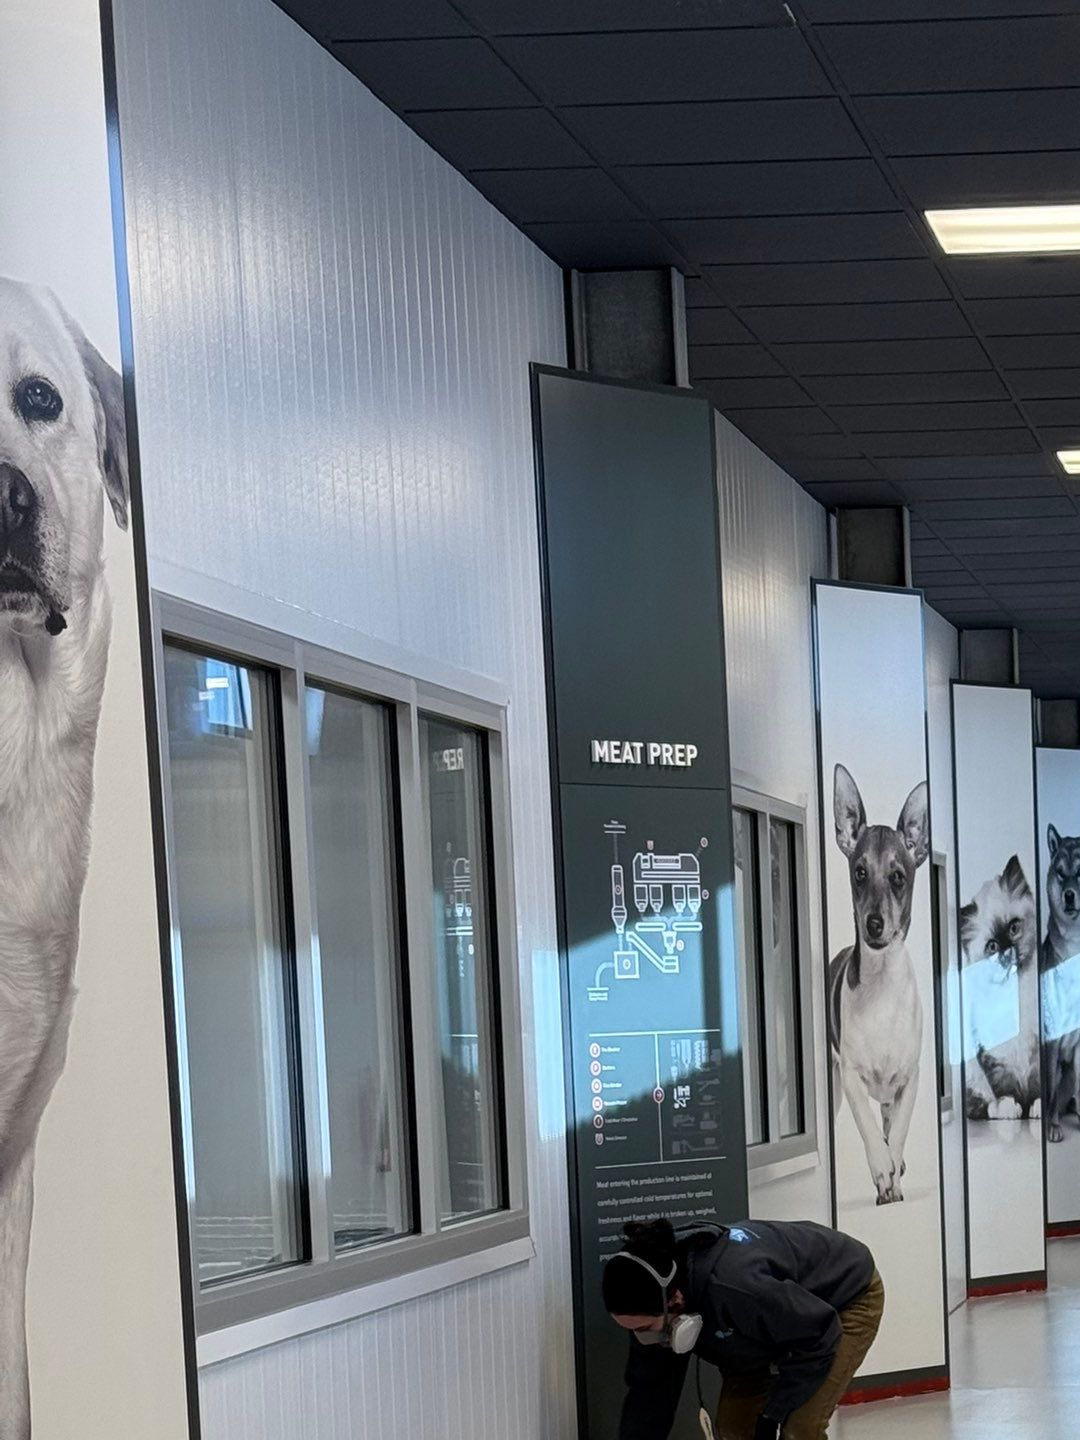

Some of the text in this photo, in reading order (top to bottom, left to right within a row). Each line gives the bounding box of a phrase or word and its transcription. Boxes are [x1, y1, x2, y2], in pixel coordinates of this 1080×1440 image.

[591, 740, 698, 766] MEAT PREP
[640, 1177, 664, 1185] production
